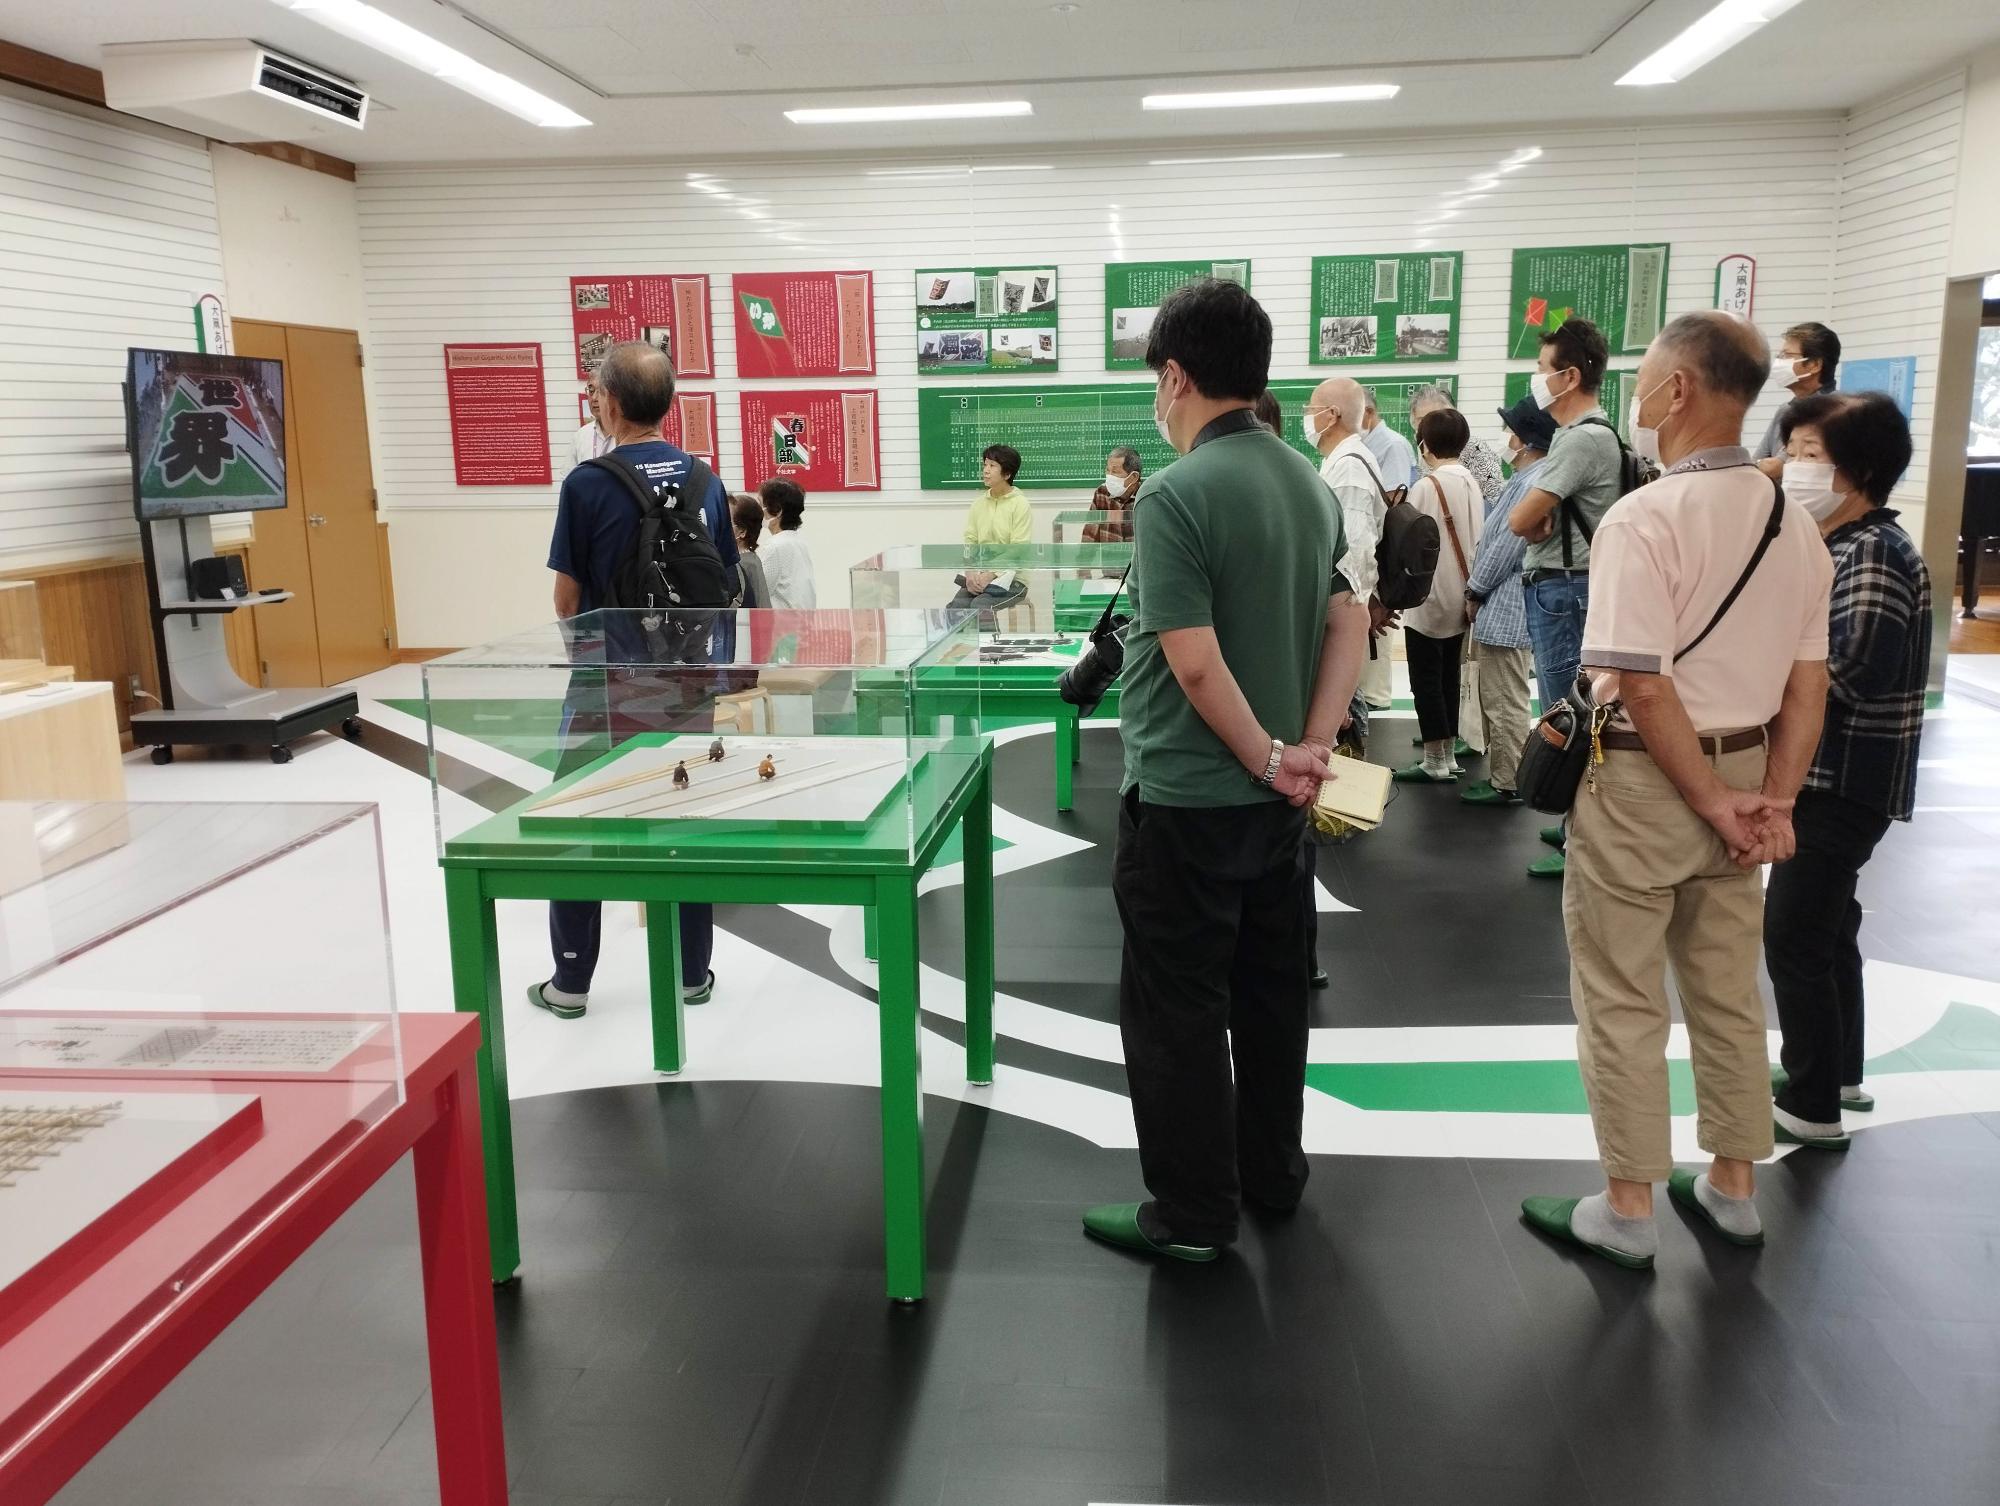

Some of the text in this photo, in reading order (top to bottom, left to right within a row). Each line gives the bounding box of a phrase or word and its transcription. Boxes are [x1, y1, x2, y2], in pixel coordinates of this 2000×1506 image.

[152, 378, 244, 488] 世界
[779, 418, 805, 464] 春日部
